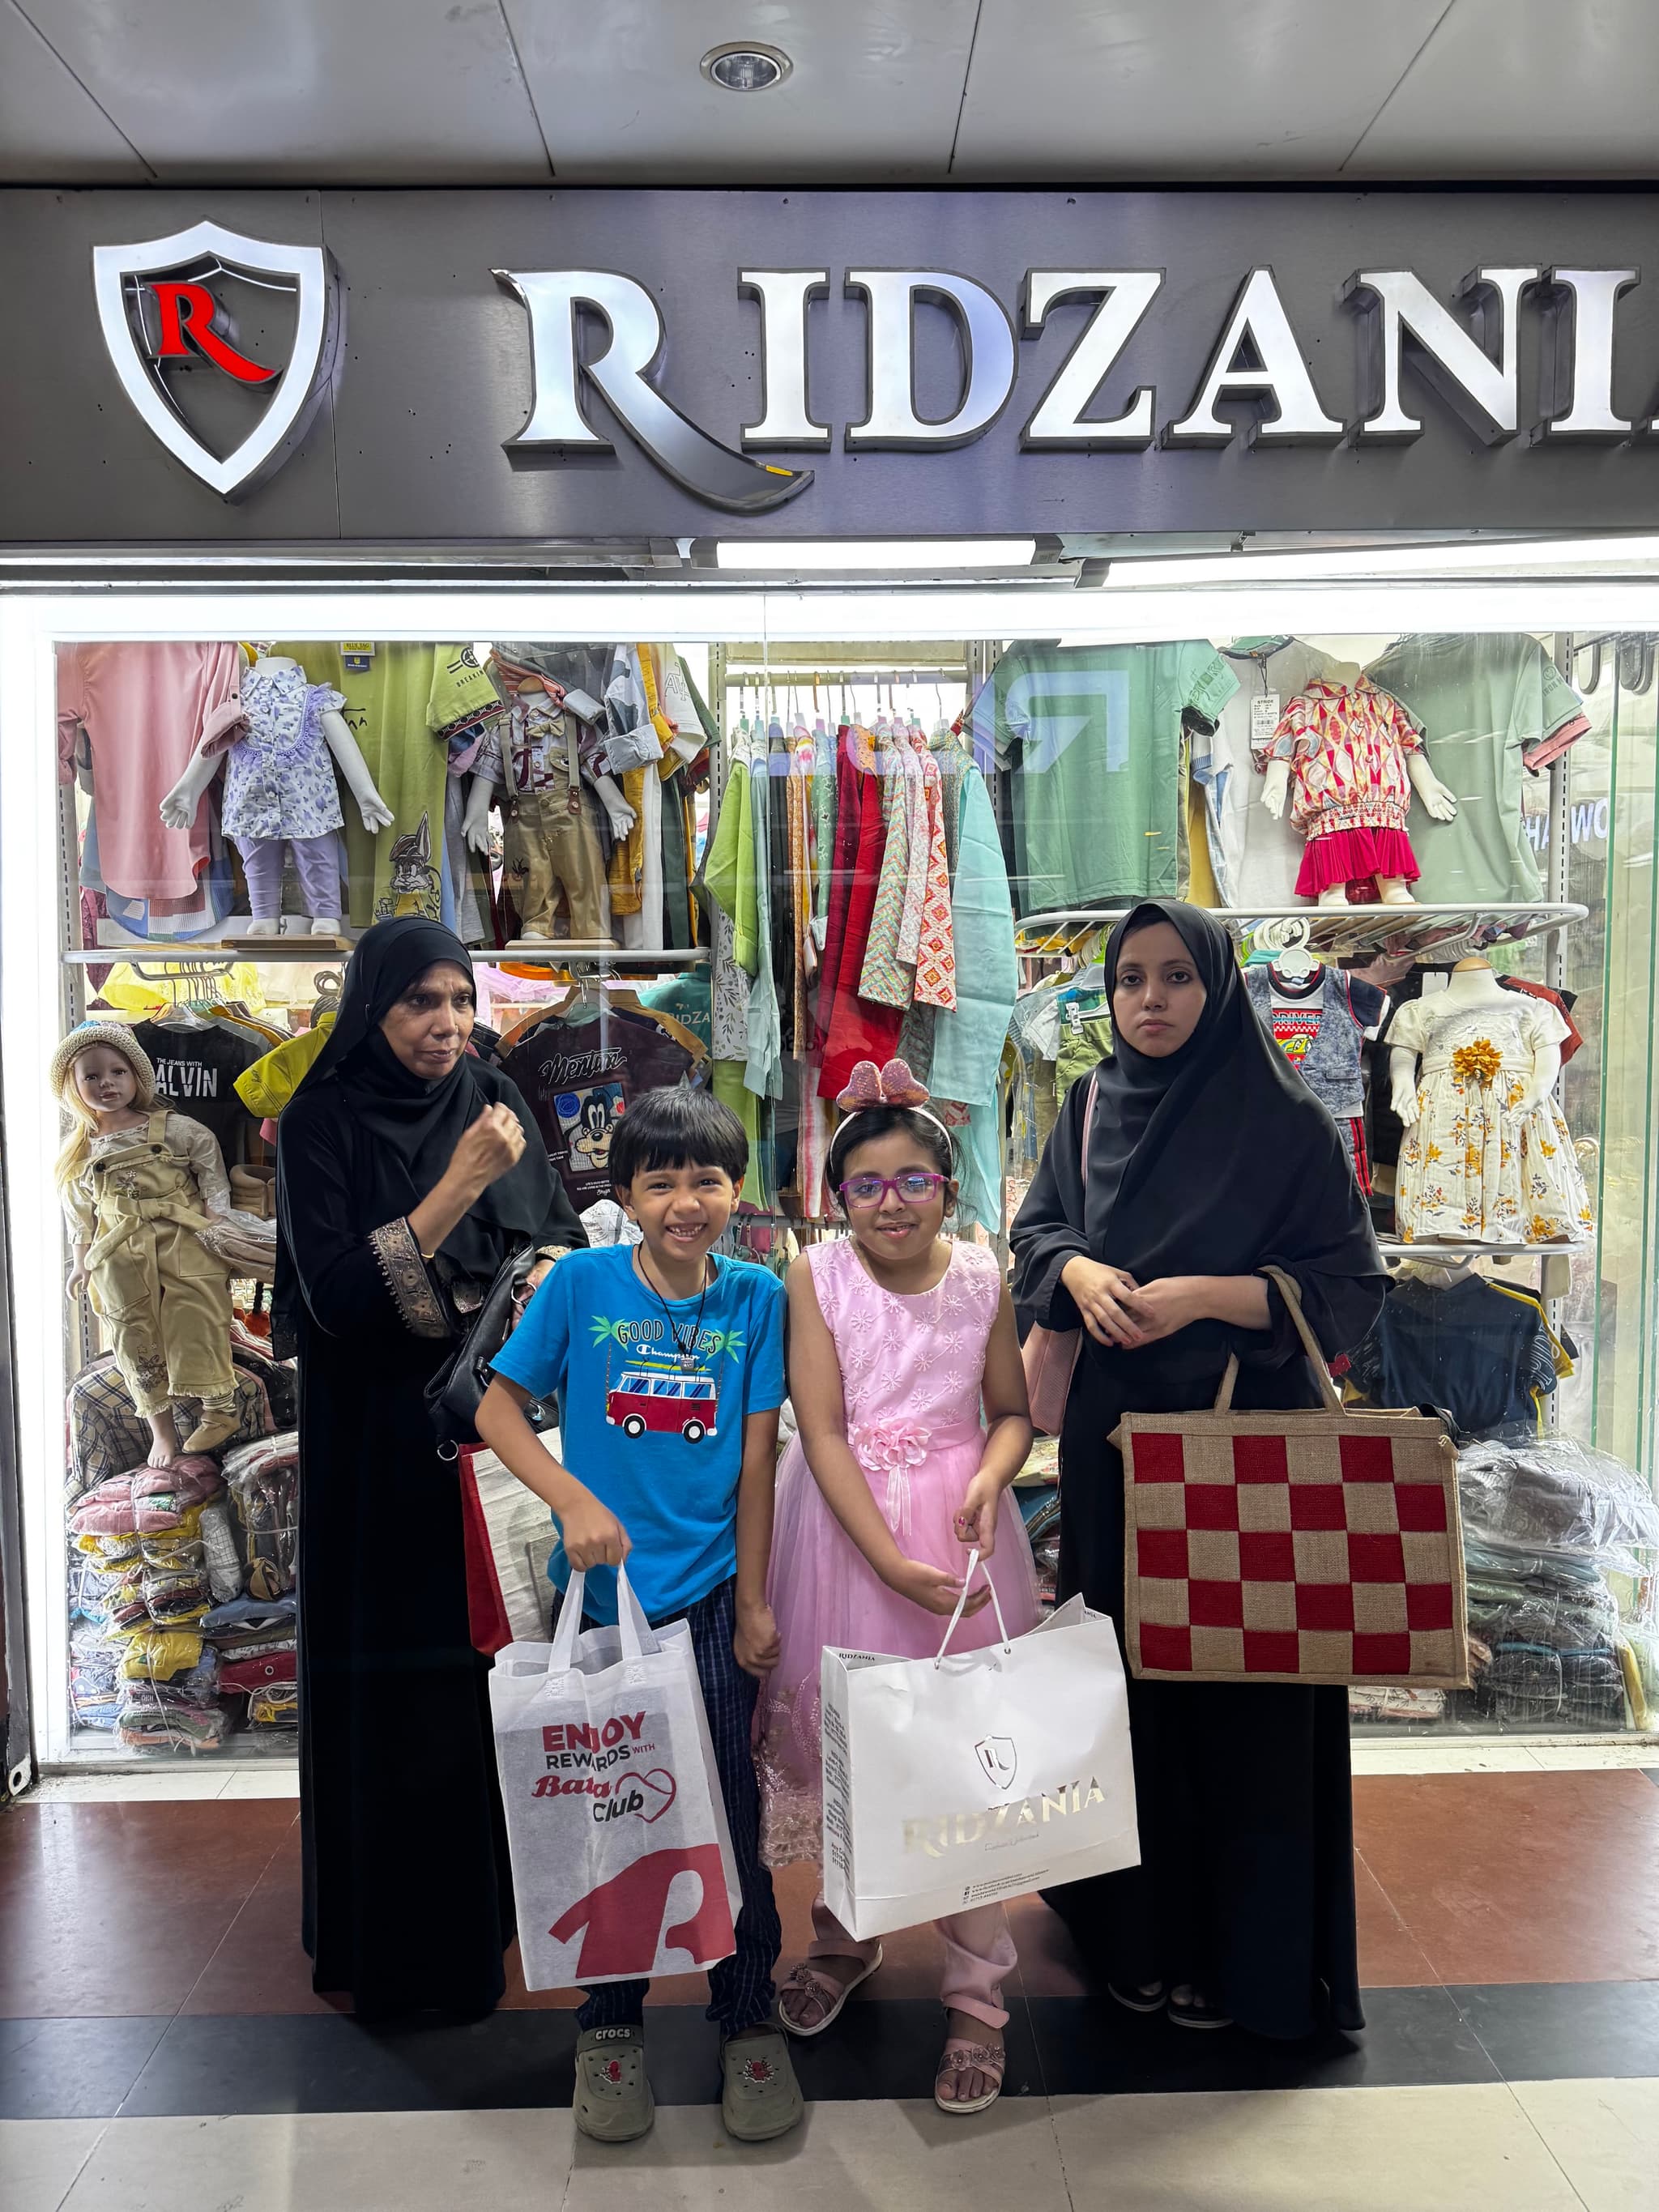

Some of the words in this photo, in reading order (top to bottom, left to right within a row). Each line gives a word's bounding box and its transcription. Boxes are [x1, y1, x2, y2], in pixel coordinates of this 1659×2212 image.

[147, 280, 285, 384] R
[489, 263, 1659, 515] RIDZANI
[669, 1010, 710, 1025] IDZA
[617, 1319, 663, 1345] GOOD
[672, 1321, 721, 1354] VIBES
[542, 1711, 646, 1754] ENJOY
[546, 1745, 631, 1771] REWARDS
[632, 1743, 655, 1754] WITH
[593, 1790, 644, 1822] Club
[595, 2028, 630, 2040] crocs
